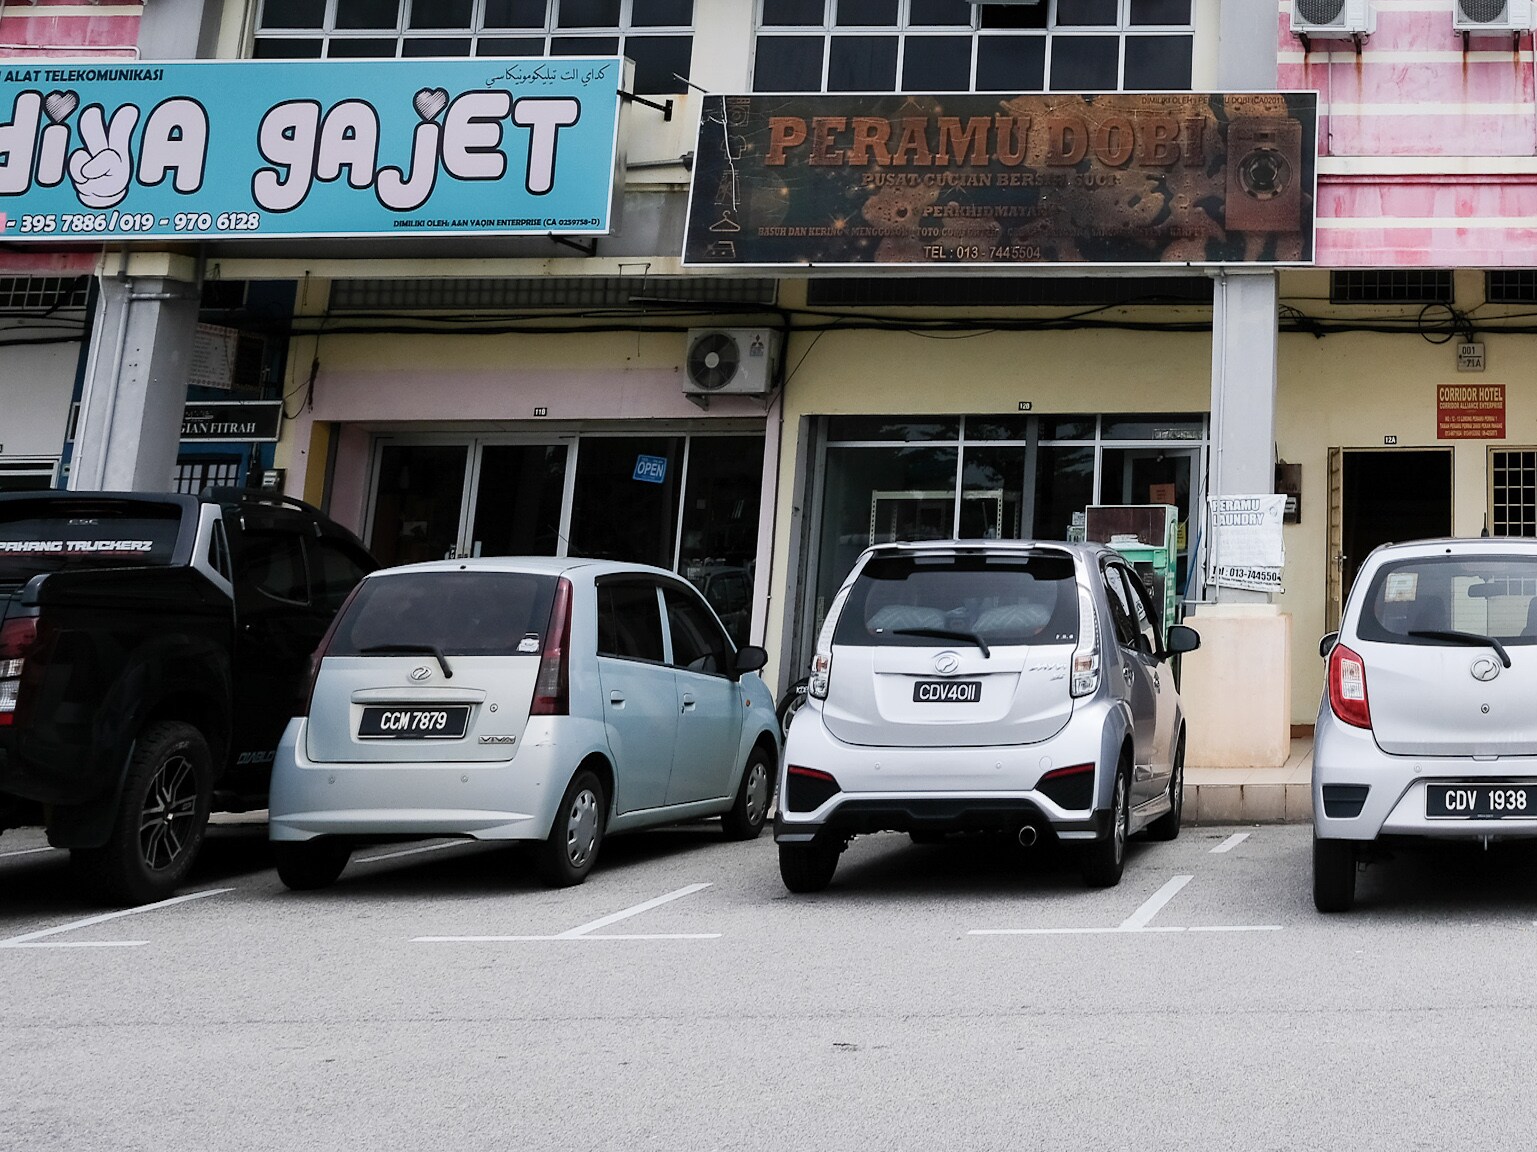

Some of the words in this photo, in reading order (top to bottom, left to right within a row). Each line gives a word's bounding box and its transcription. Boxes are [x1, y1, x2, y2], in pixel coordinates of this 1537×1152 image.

[4, 70, 40, 82] ALAT
[44, 69, 163, 82] TELEKOMUNIKASI
[764, 116, 1031, 167] PERAMU
[1047, 116, 1207, 168] DOBI
[862, 173, 919, 186] PUSAT
[921, 172, 992, 186] CUCIAN
[20, 214, 57, 232] 395
[174, 214, 211, 231] 970
[215, 213, 261, 231] 6128
[393, 220, 425, 228] DIMILIKI
[427, 220, 450, 228] OLEH:
[470, 220, 495, 228] YAQIN
[496, 219, 541, 227] ENTERPRISE
[543, 219, 556, 227] (CA
[758, 227, 787, 237] BASUH
[788, 227, 806, 237] DAN
[808, 227, 843, 237] KERING
[916, 227, 939, 237] TOTO
[924, 247, 946, 259] TEL
[956, 247, 978, 259] 013
[989, 246, 1041, 259] 7445504
[1440, 388, 1477, 401] CORRIDOR
[1480, 388, 1502, 401] HOTEL
[210, 422, 256, 433] FITRAH
[637, 461, 664, 477] OPEN
[1212, 499, 1260, 512] PERAMU
[1213, 513, 1264, 527] LAUNDRY
[0, 541, 63, 551] PAHANG
[66, 541, 153, 551] TRUCKERZ
[1213, 566, 1224, 576] Tl
[380, 712, 410, 730] CCM
[412, 711, 447, 730] 7879
[1445, 791, 1477, 810] CDV
[1488, 791, 1527, 810] 1938
